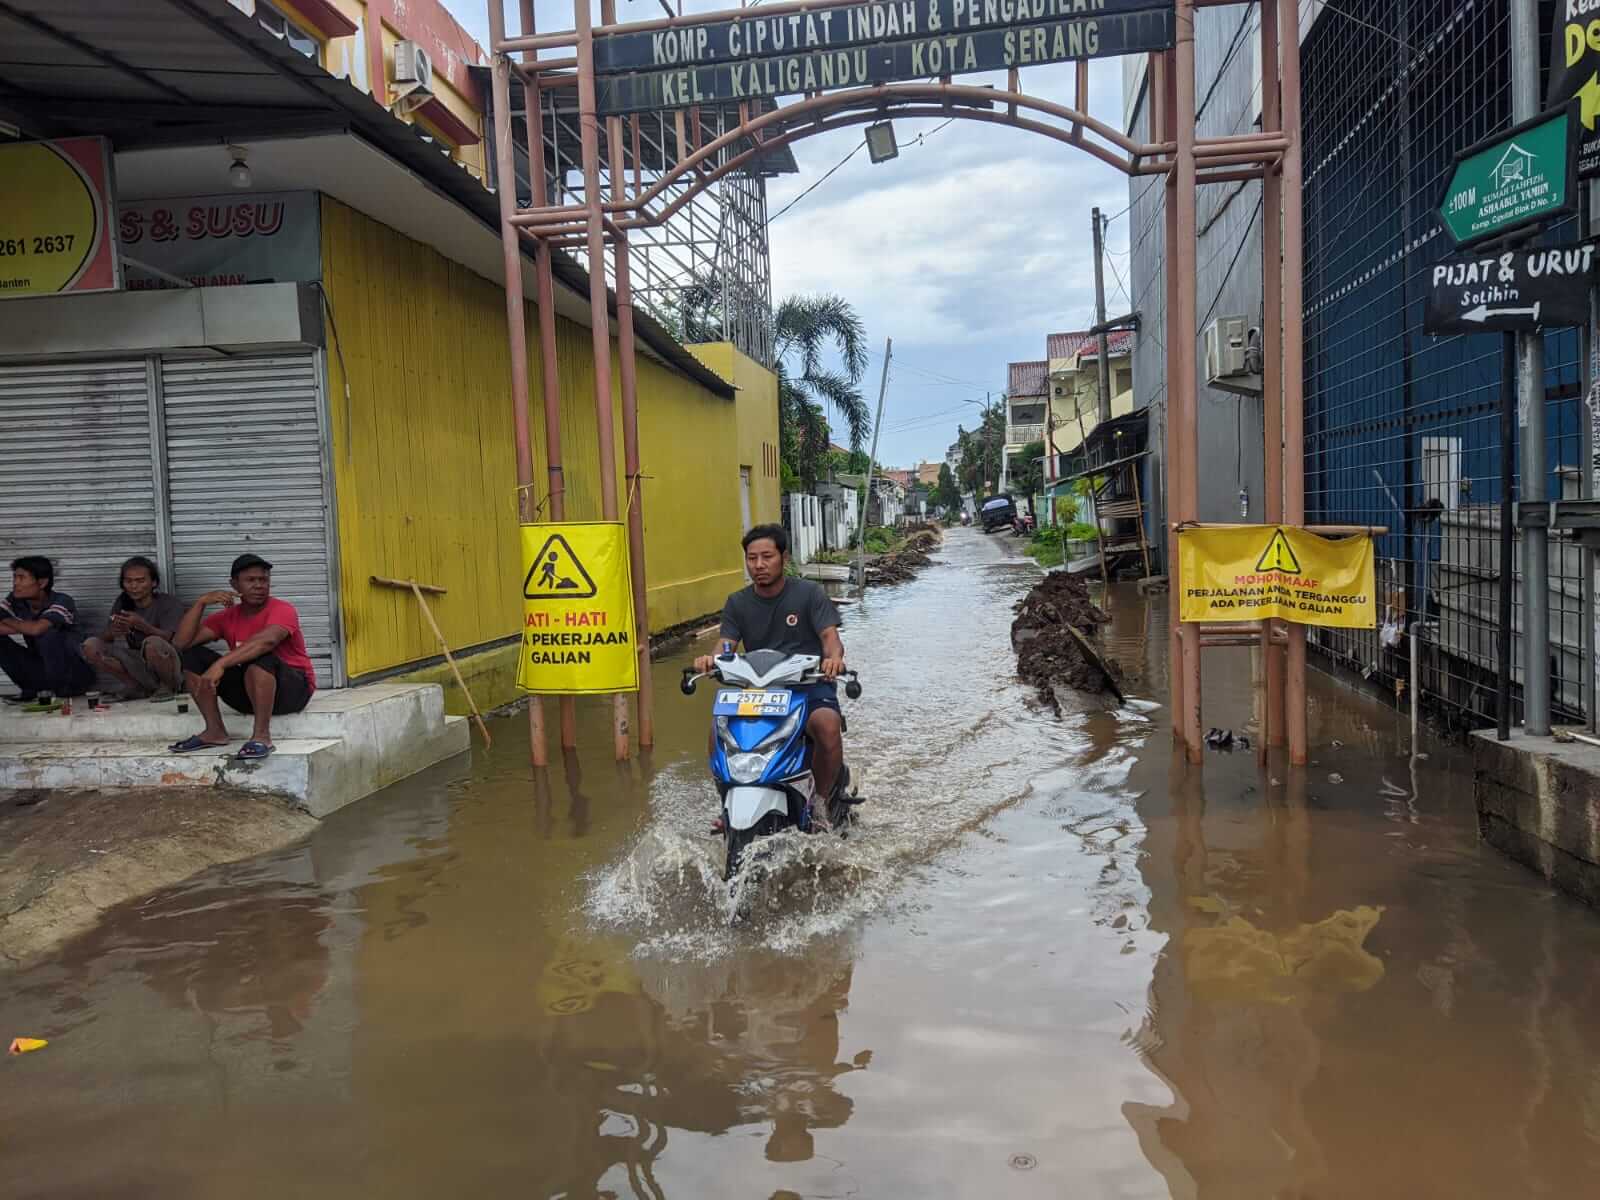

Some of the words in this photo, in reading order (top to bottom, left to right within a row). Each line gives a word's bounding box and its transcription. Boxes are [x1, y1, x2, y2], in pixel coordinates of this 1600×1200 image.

[652, 28, 715, 64] KOMP.
[728, 11, 832, 56] CIPUTAT
[848, 0, 917, 41] INDAH
[927, 2, 943, 32] &
[661, 70, 715, 105] KEL.
[730, 50, 868, 97] KALIGANDU
[911, 36, 978, 75] KOTA
[1003, 21, 1099, 65] SERANG
[187, 202, 285, 240] SUSU
[33, 234, 75, 254] 2637
[1433, 259, 1496, 287] PIJAT
[1498, 252, 1515, 282] &
[1527, 245, 1595, 278] URUT
[1234, 573, 1281, 585] MOHON
[1281, 576, 1319, 589] MAAF
[1187, 587, 1265, 598] PERJALANAN
[1266, 584, 1292, 597] ANDA
[1294, 590, 1367, 604] TERGANGGU
[1210, 599, 1236, 609] ADA
[1238, 597, 1296, 609] PEKERJAAN
[1299, 602, 1343, 614] GALIAN
[565, 612, 607, 627] HATI
[532, 632, 628, 646] PEKERJAAN
[531, 651, 591, 665] GALIAN
[722, 694, 728, 703] A
[737, 694, 765, 703] 2577
[770, 694, 785, 703] CT
